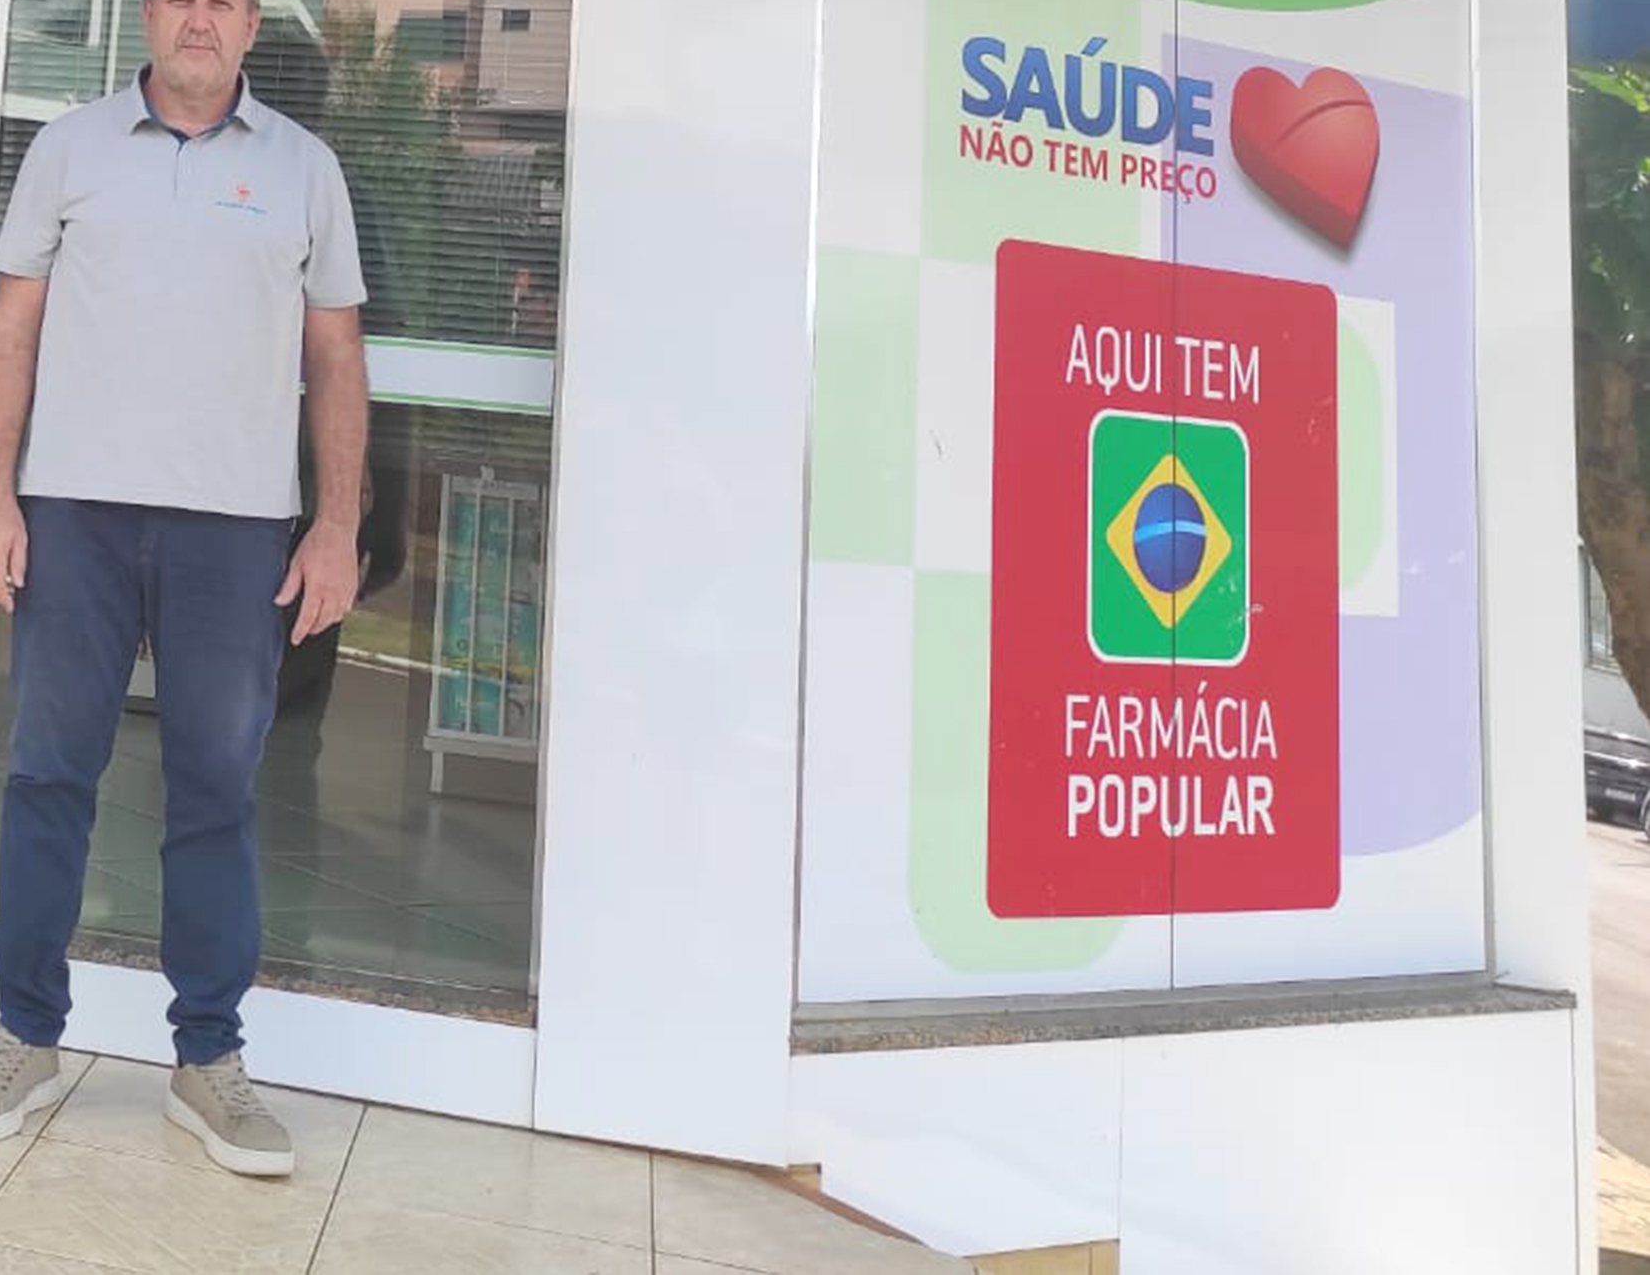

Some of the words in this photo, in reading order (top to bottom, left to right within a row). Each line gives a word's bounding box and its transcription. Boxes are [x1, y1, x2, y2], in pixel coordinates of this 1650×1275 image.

[961, 36, 1215, 158] SAÚDE
[958, 121, 1035, 169] NÃO
[1043, 138, 1109, 182] TEM
[1120, 152, 1218, 205] PREÇO
[1065, 323, 1162, 396] AQUI
[1174, 335, 1261, 405] TEM
[1064, 680, 1279, 760] FARMÁCIA
[1066, 773, 1277, 839] POPULAR
